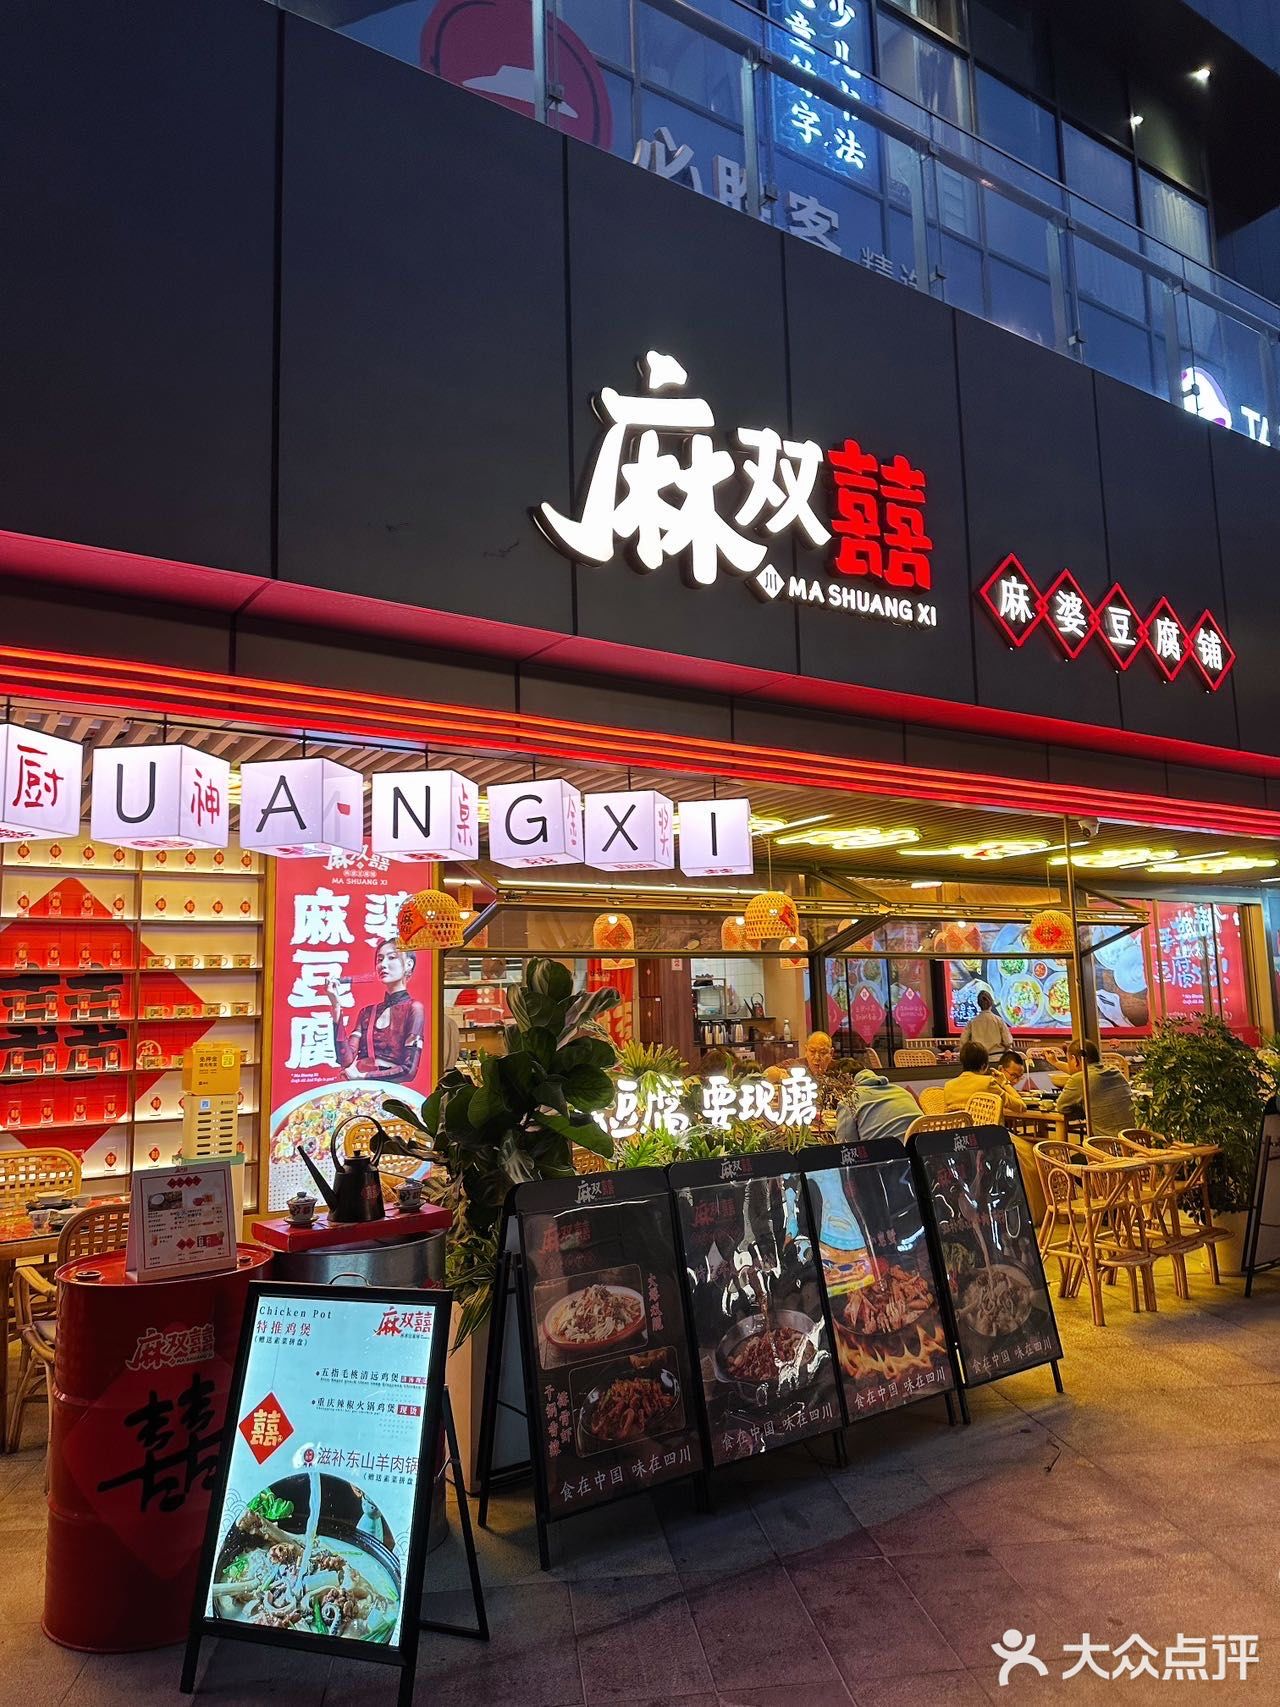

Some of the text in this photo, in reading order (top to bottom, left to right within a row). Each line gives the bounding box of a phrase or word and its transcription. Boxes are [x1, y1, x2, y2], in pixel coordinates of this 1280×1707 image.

[787, 577, 938, 627] MA SHUANG XI
[1000, 576, 1224, 670] 麻婆豆腐铺
[12, 744, 64, 808] 厨
[190, 768, 220, 827] 神
[332, 877, 345, 885] MA
[346, 878, 378, 886] SHUANG
[256, 1319, 311, 1337] 特推鸡煲
[259, 1305, 332, 1320] Chicken Pot
[972, 1336, 1053, 1374] 食在中国 味在四川
[854, 1367, 946, 1410] 食在中国 味在四川
[722, 1421, 775, 1451] 食在中国
[317, 1447, 419, 1474] 滋补东山羊肉锅
[560, 1445, 692, 1501] 食在中国 味在四川
